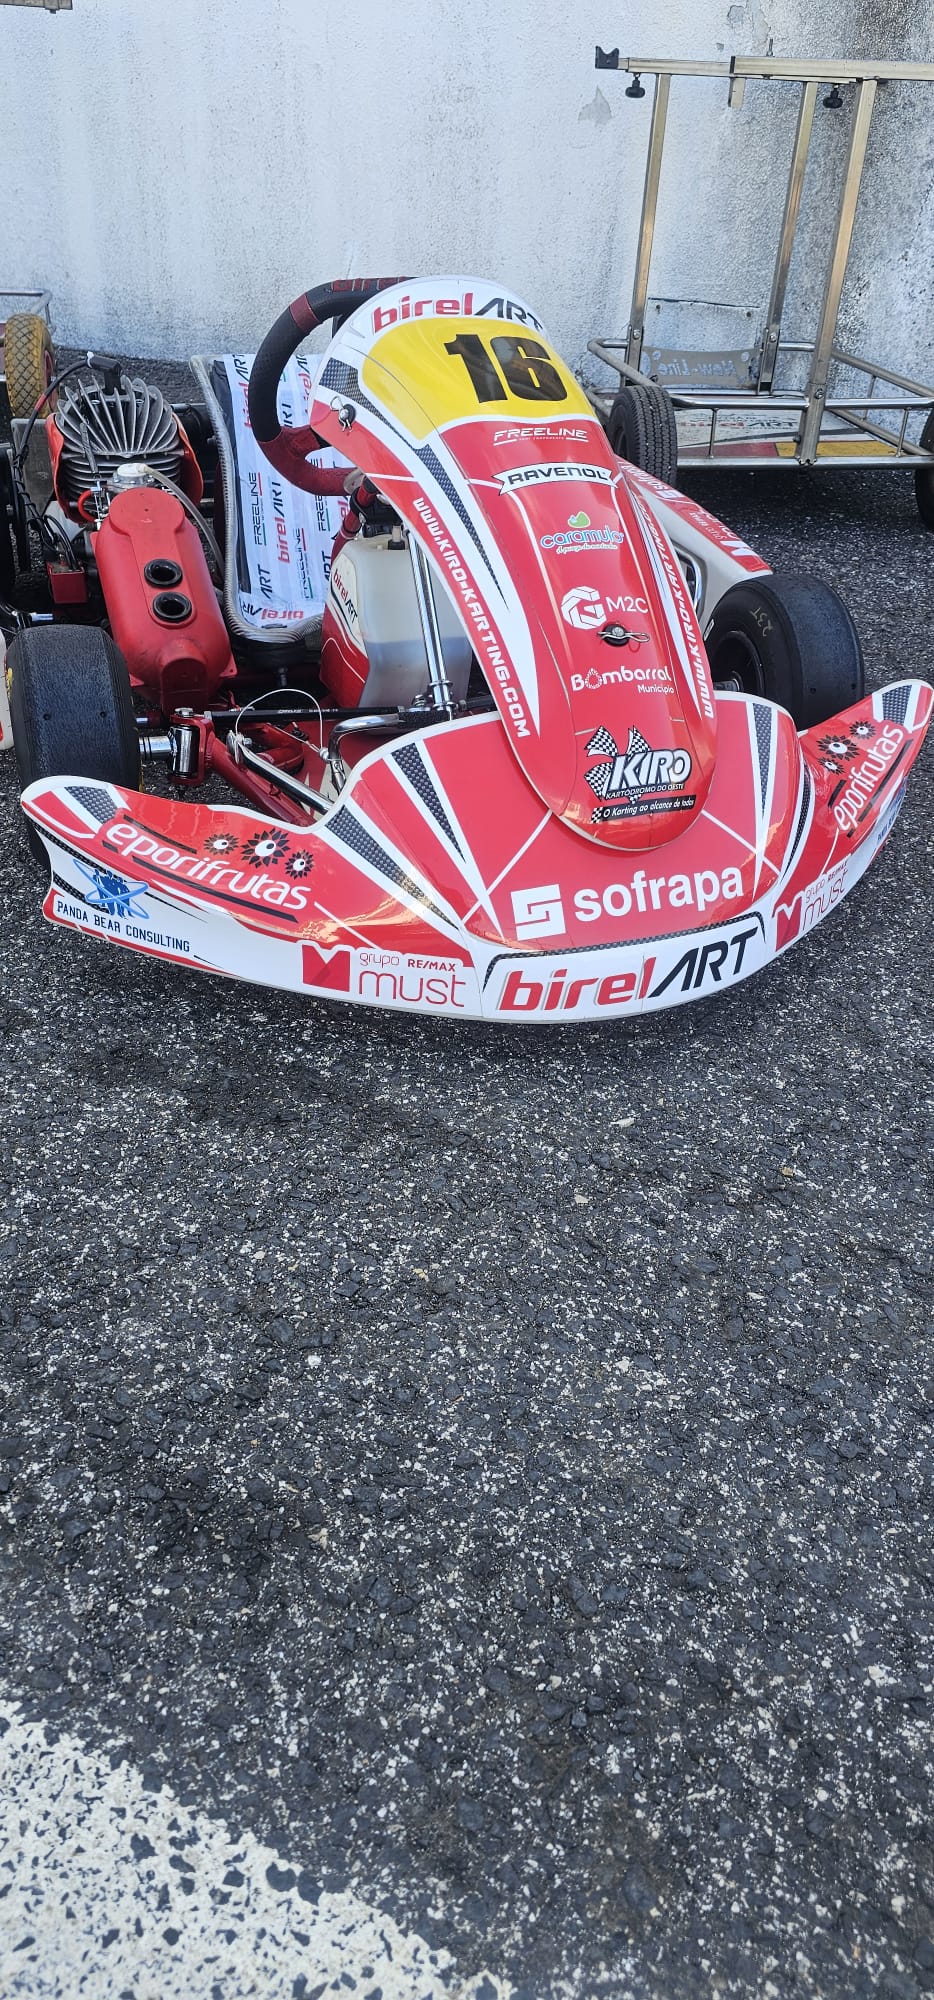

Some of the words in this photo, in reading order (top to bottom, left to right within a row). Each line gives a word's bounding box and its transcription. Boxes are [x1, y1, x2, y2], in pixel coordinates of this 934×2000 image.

[373, 293, 544, 333] birelART
[444, 334, 568, 403] 16
[494, 428, 588, 441] FREELINE
[508, 467, 612, 484] RAVENOL
[249, 472, 263, 546] FREELINE
[272, 482, 290, 564] birelART
[541, 525, 624, 549] caramulo
[333, 568, 358, 623] birelART
[606, 596, 648, 614] M2C
[570, 665, 672, 691] Bombarral
[608, 749, 691, 791] KIRO
[833, 721, 904, 831] eporifrutas
[603, 810, 611, 818] O
[612, 806, 638, 816] Karting
[639, 804, 648, 812] ao
[650, 801, 672, 810] alcance
[673, 799, 680, 808] de
[681, 798, 694, 806] todos
[605, 785, 656, 799] KARTODROMO
[657, 784, 667, 792] DO
[106, 823, 311, 909] eporifrutas
[573, 866, 744, 922] sofrapa
[56, 901, 89, 923] PANDA
[94, 914, 121, 933] BEAR
[126, 924, 190, 952] CONSULTING
[359, 952, 399, 968] grupo
[407, 959, 456, 973] RE/MAX
[499, 926, 758, 1011] birelART
[359, 971, 466, 1008] must
